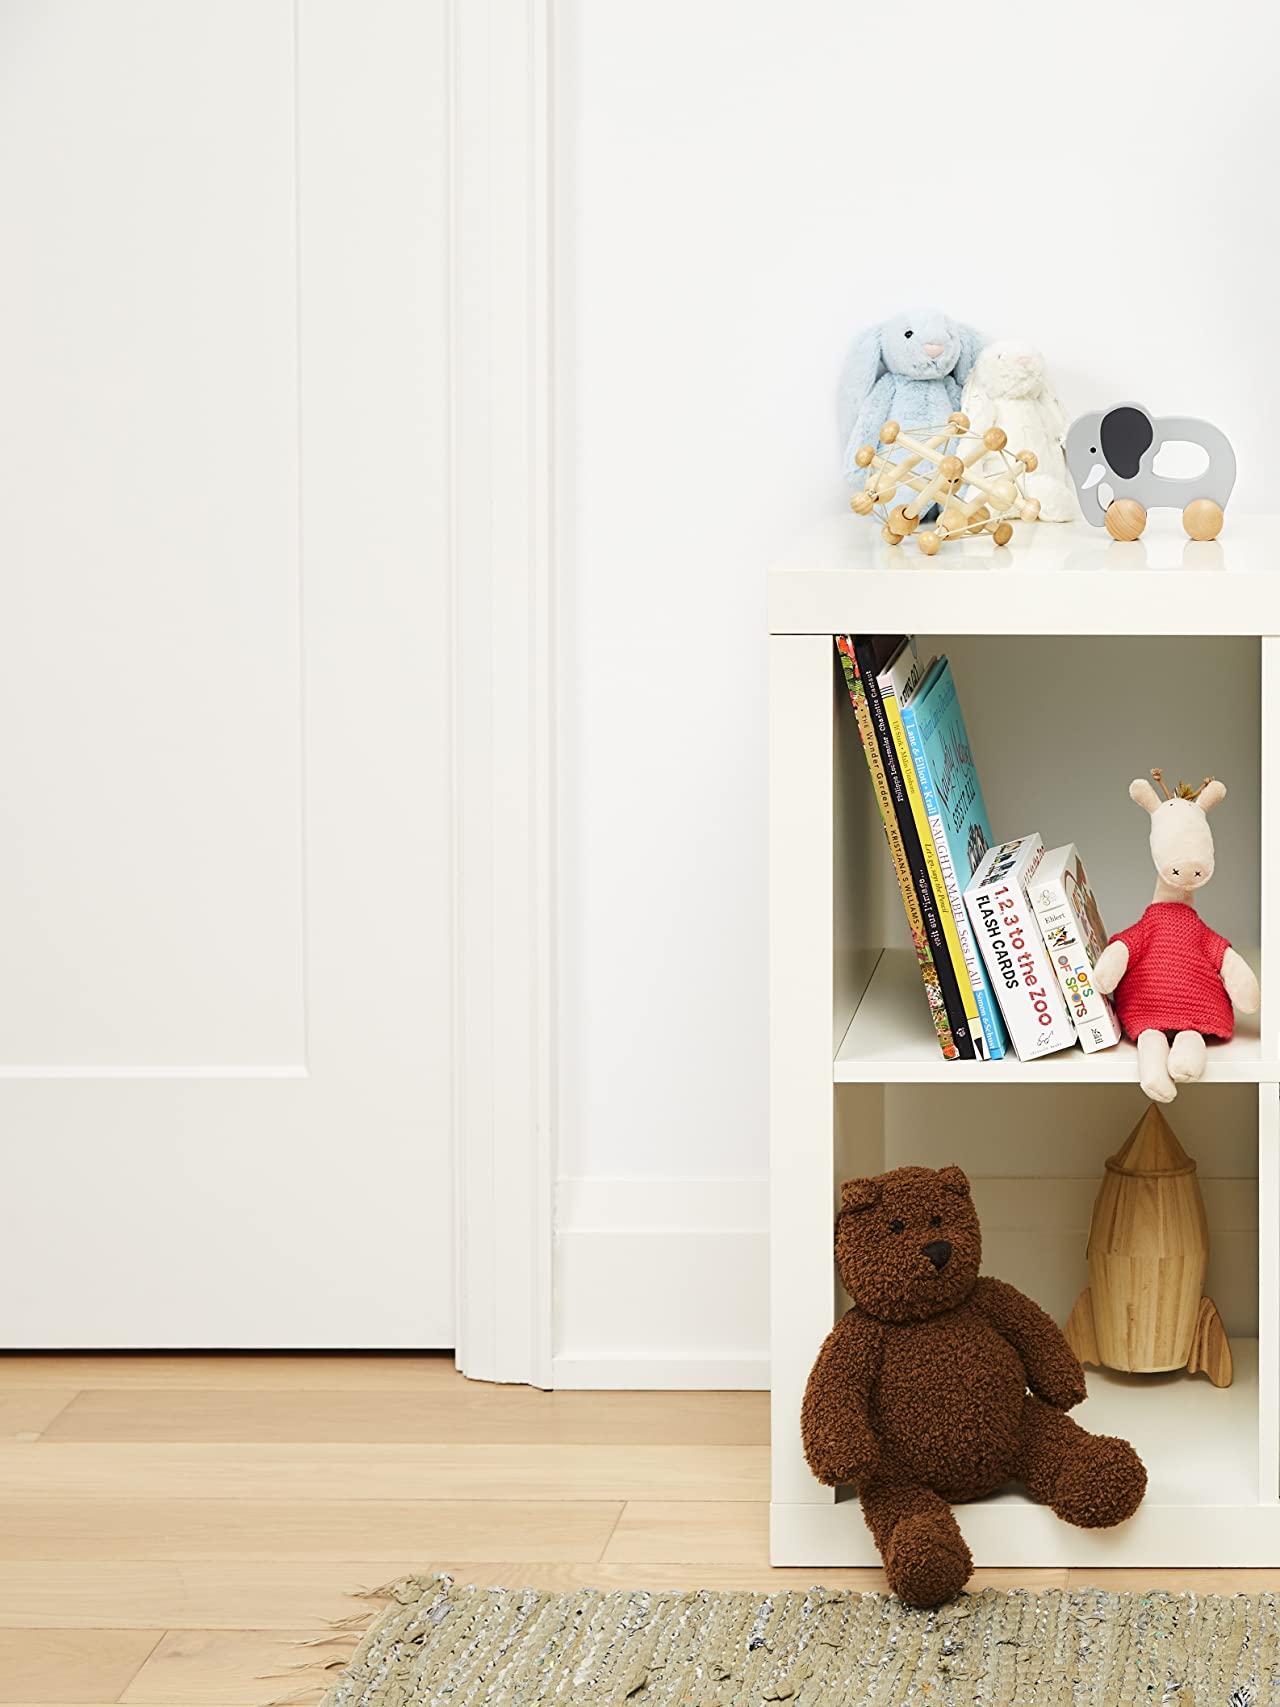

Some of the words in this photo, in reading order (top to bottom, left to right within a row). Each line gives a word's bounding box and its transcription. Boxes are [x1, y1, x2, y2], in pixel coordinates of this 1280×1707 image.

[873, 699, 886, 732] Charlotte
[906, 723, 917, 746] Lane
[914, 756, 928, 785] Elliott
[861, 714, 869, 729] THE
[866, 731, 880, 769] Wonder
[876, 772, 890, 808] Garden
[890, 829, 907, 875] KRISTJANA
[904, 884, 921, 924] WILLIAMS
[923, 791, 938, 815] Krall
[930, 818, 955, 880] NAUGHTY
[924, 843, 934, 859] Let's
[938, 894, 949, 914] Pencil
[946, 883, 965, 927] MABEL
[1044, 912, 1067, 925] Ehlert
[959, 929, 970, 955] Sees
[975, 895, 1002, 938] FLASH
[992, 939, 1019, 989] CARDS
[1008, 927, 1025, 950] to
[1017, 952, 1038, 987] the
[966, 957, 976, 966] It
[968, 970, 983, 987] All
[1057, 955, 1072, 972] OF
[1065, 976, 1088, 1018] SPOTS
[1074, 965, 1095, 998] LOTS
[976, 992, 987, 1016] Simon
